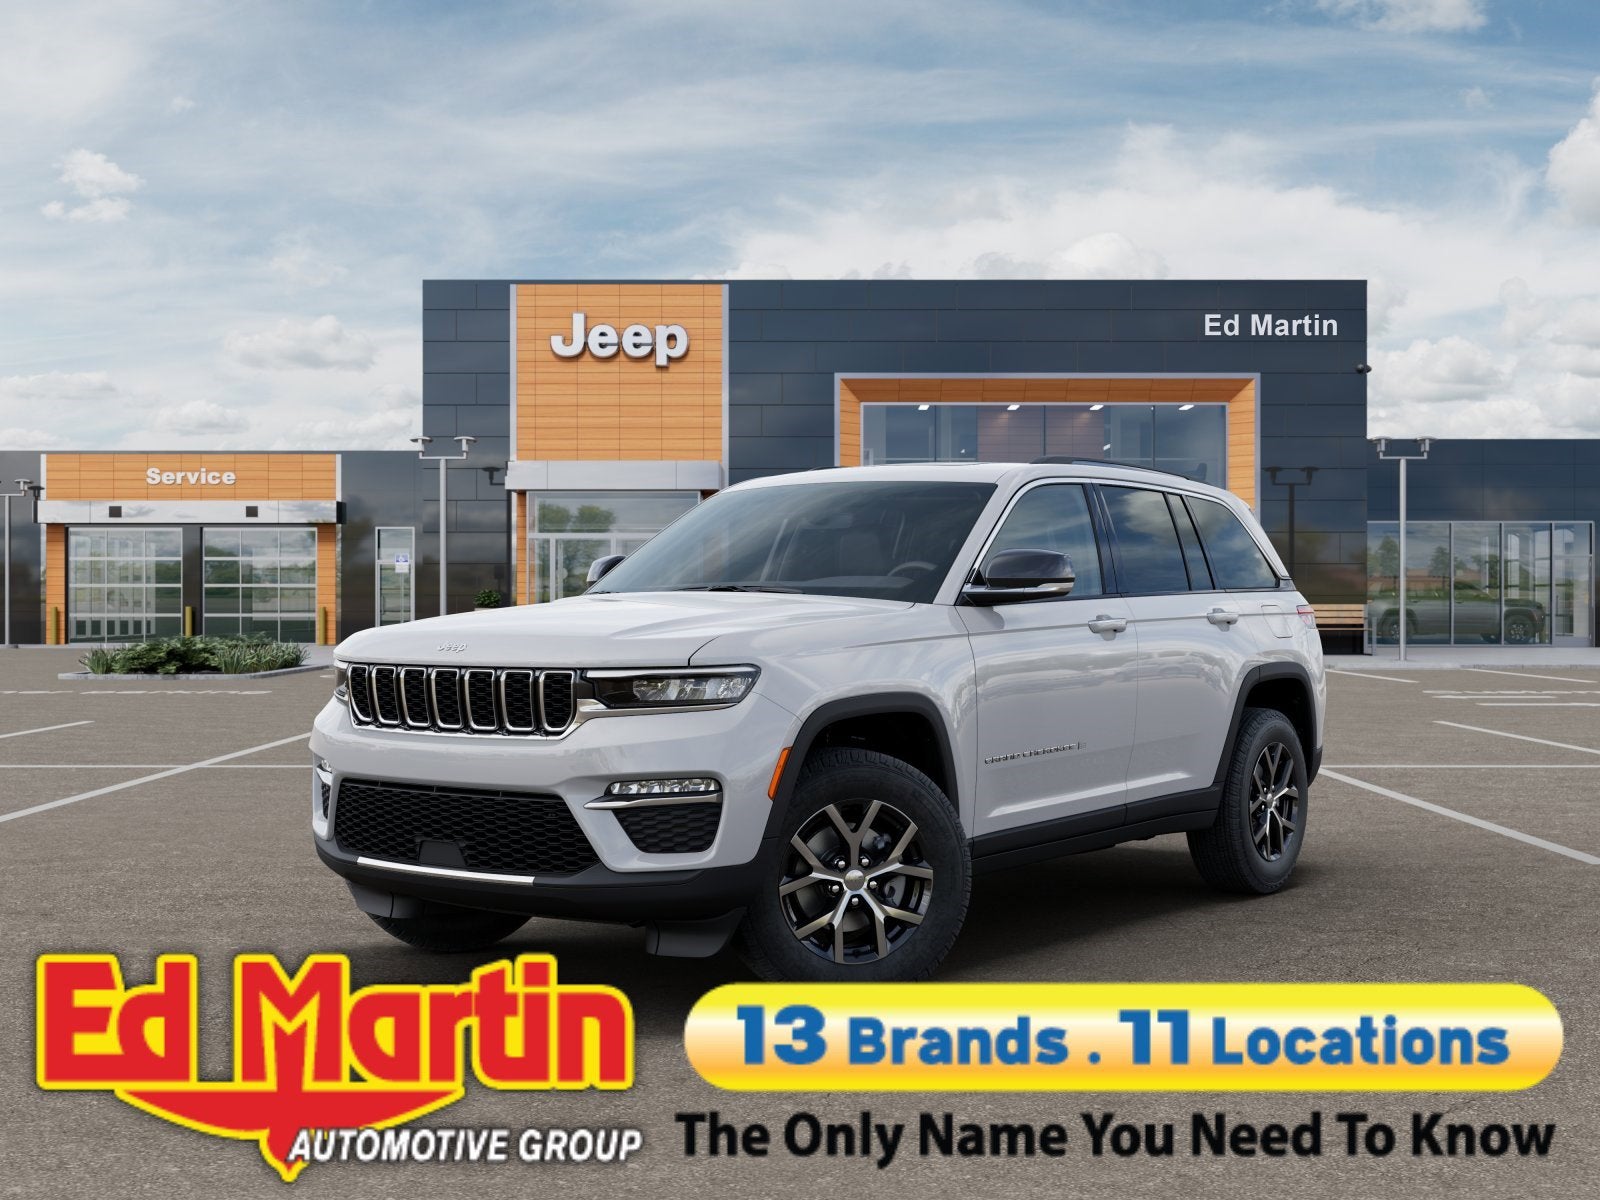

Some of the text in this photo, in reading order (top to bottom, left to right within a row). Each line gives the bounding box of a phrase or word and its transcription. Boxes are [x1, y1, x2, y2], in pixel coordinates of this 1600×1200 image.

[1204, 314, 1338, 336] Ed Martin
[550, 312, 690, 367] Jeep
[146, 467, 236, 485] Service
[437, 642, 467, 654] Jeep
